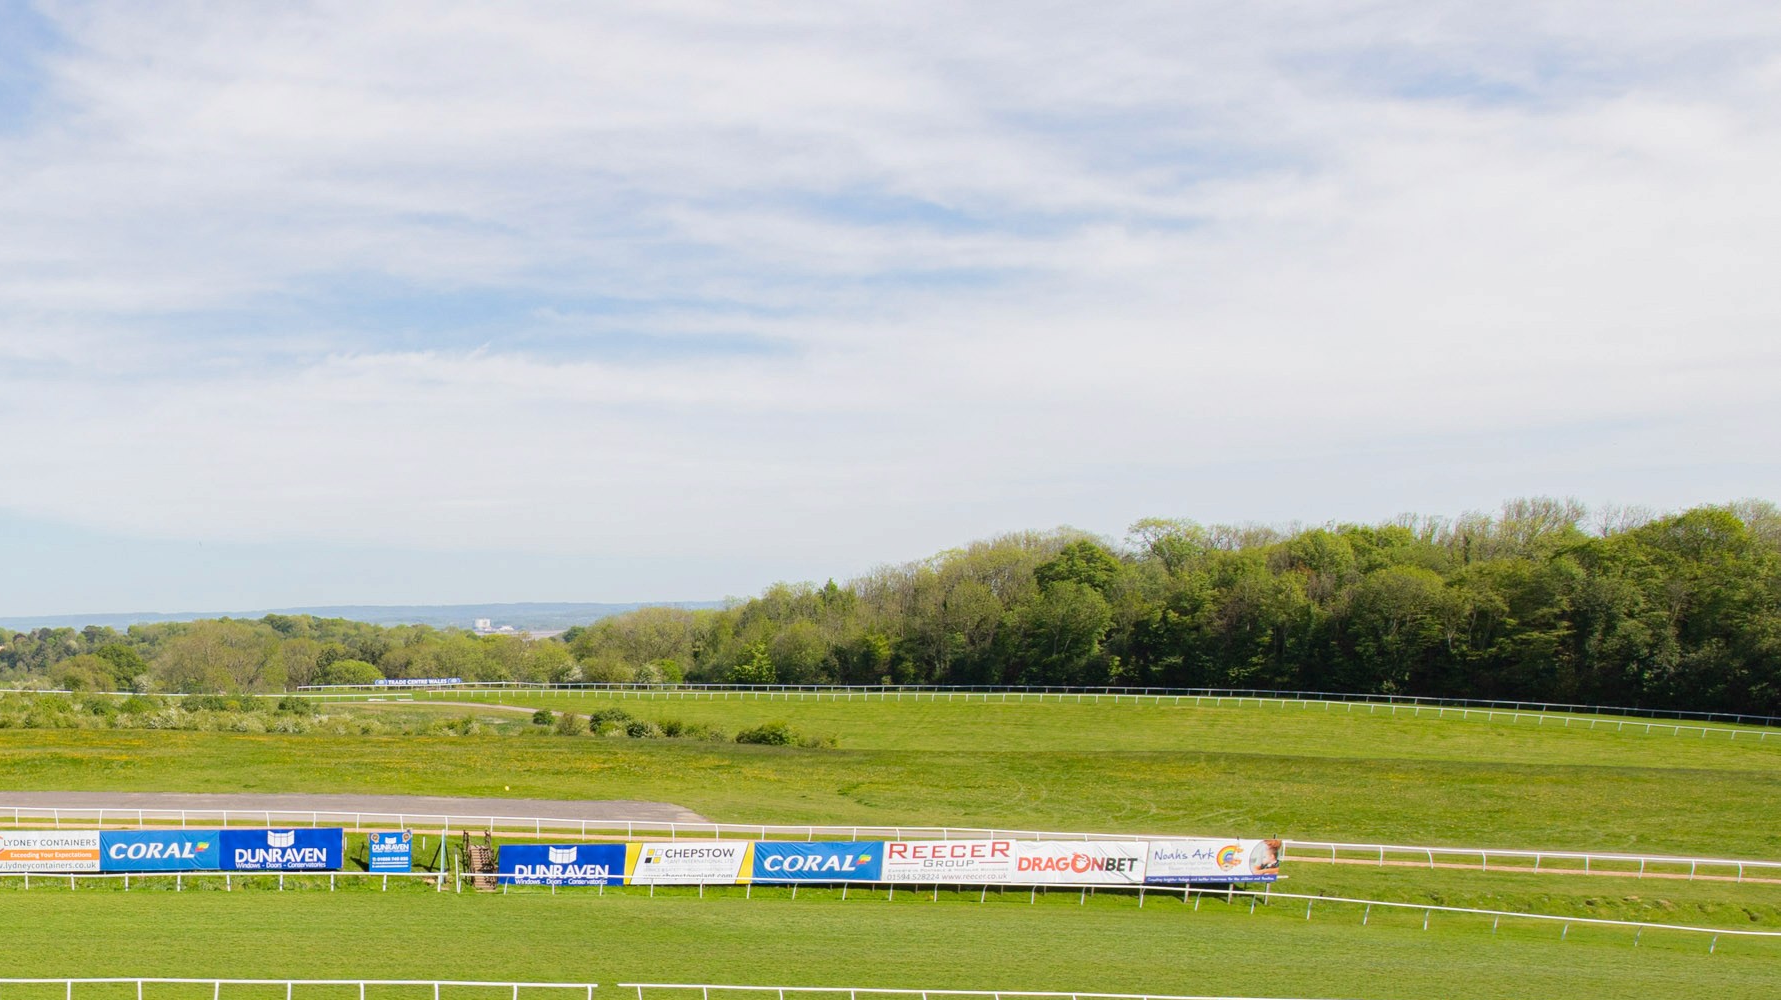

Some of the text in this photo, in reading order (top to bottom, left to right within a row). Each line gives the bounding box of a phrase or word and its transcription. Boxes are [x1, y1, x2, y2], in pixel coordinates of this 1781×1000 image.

[3, 839, 97, 847] LYDNEY CONTAINERS
[372, 843, 409, 851] DUNRAVEN
[888, 841, 1010, 859] REECER
[109, 842, 195, 860] CORAL
[235, 848, 327, 863] DUNRAVEN
[665, 848, 735, 858] CHEPSTOW
[1154, 848, 1216, 861] Noah's Ark
[763, 854, 856, 872] CORAL
[923, 859, 975, 868] GROUP
[1017, 853, 1138, 873] DRAGONBET
[515, 864, 609, 879] DUNRAVEN
[942, 872, 1007, 880] www.reecer.co.uk
